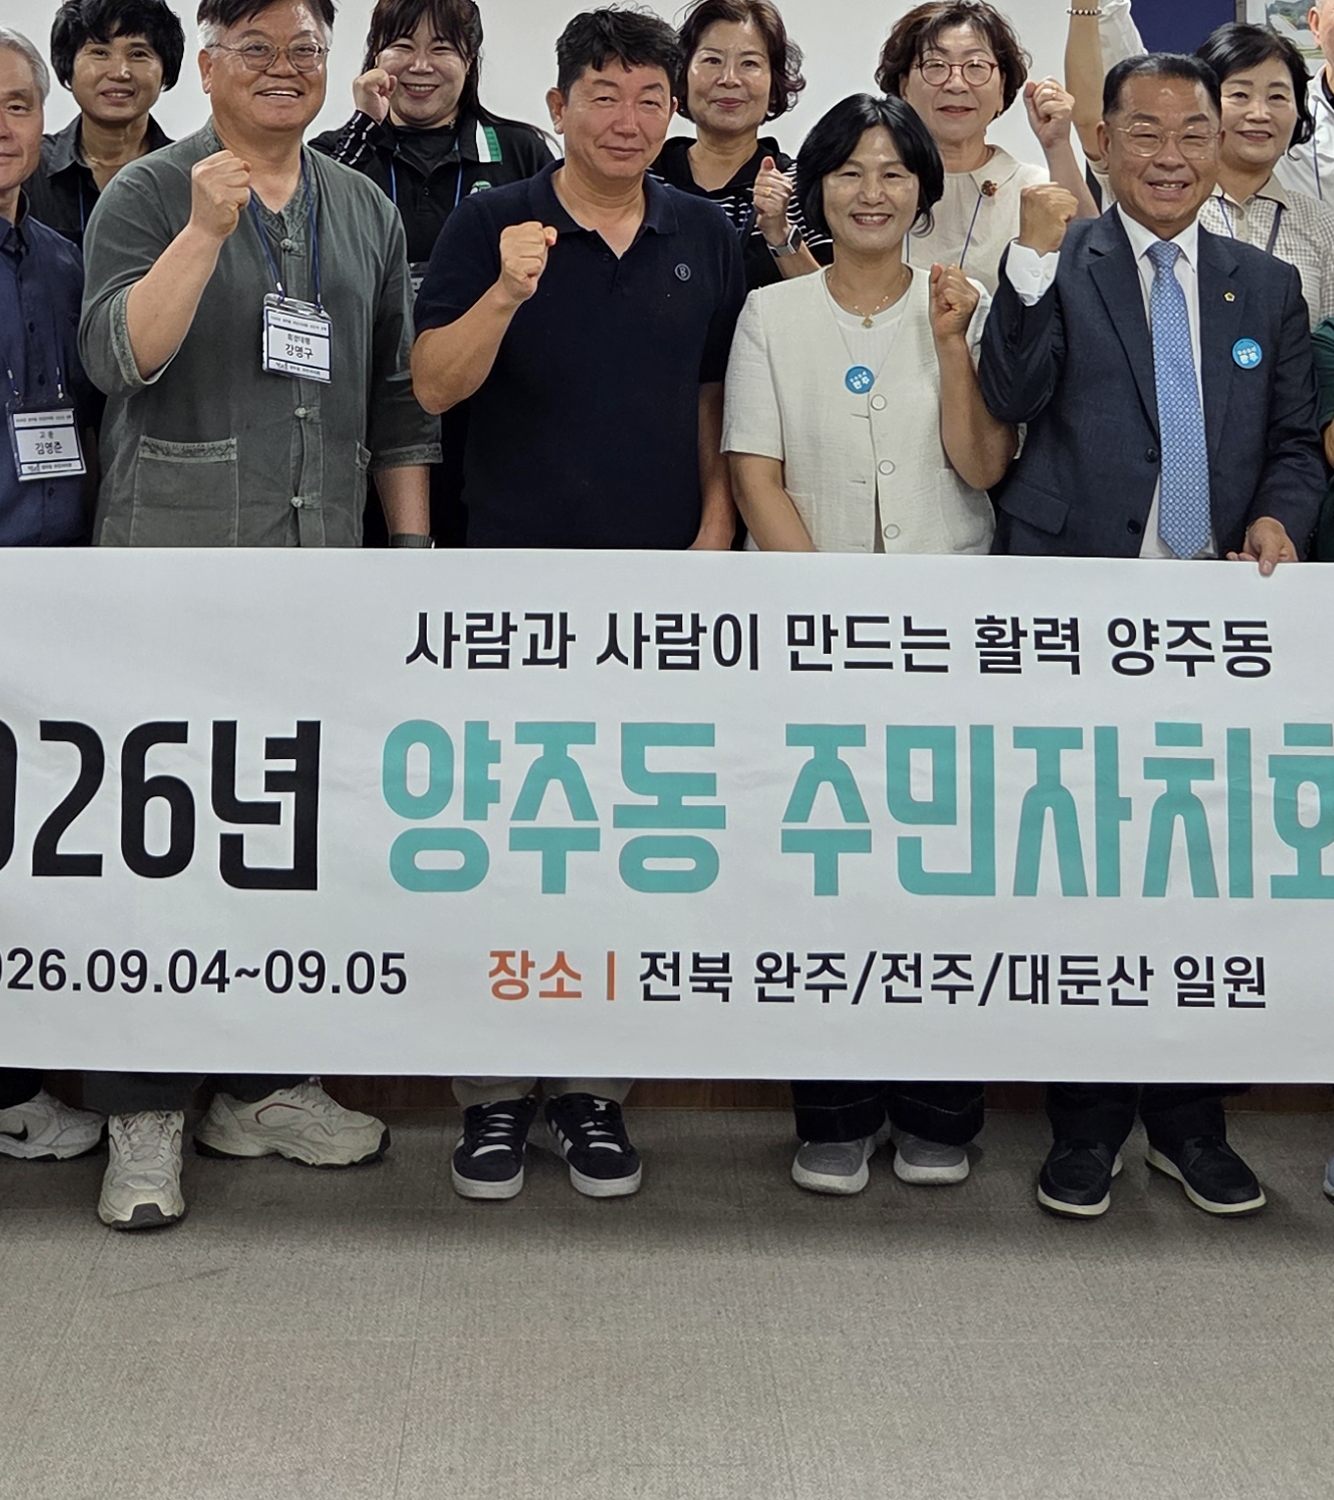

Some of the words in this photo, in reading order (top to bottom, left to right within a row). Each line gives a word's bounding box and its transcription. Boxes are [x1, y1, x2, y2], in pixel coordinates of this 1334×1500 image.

[406, 611, 576, 670] 사람과
[596, 612, 760, 671] 사람이
[786, 614, 951, 673] 만드는
[974, 615, 1081, 675] 활력
[1107, 617, 1273, 678] 양주동
[382, 718, 727, 894] 양주동
[488, 950, 582, 1001] 장소
[639, 952, 733, 1003] 전북
[754, 951, 1155, 1007] 완주/전주/대둔산
[1174, 956, 1267, 1009] 일원
